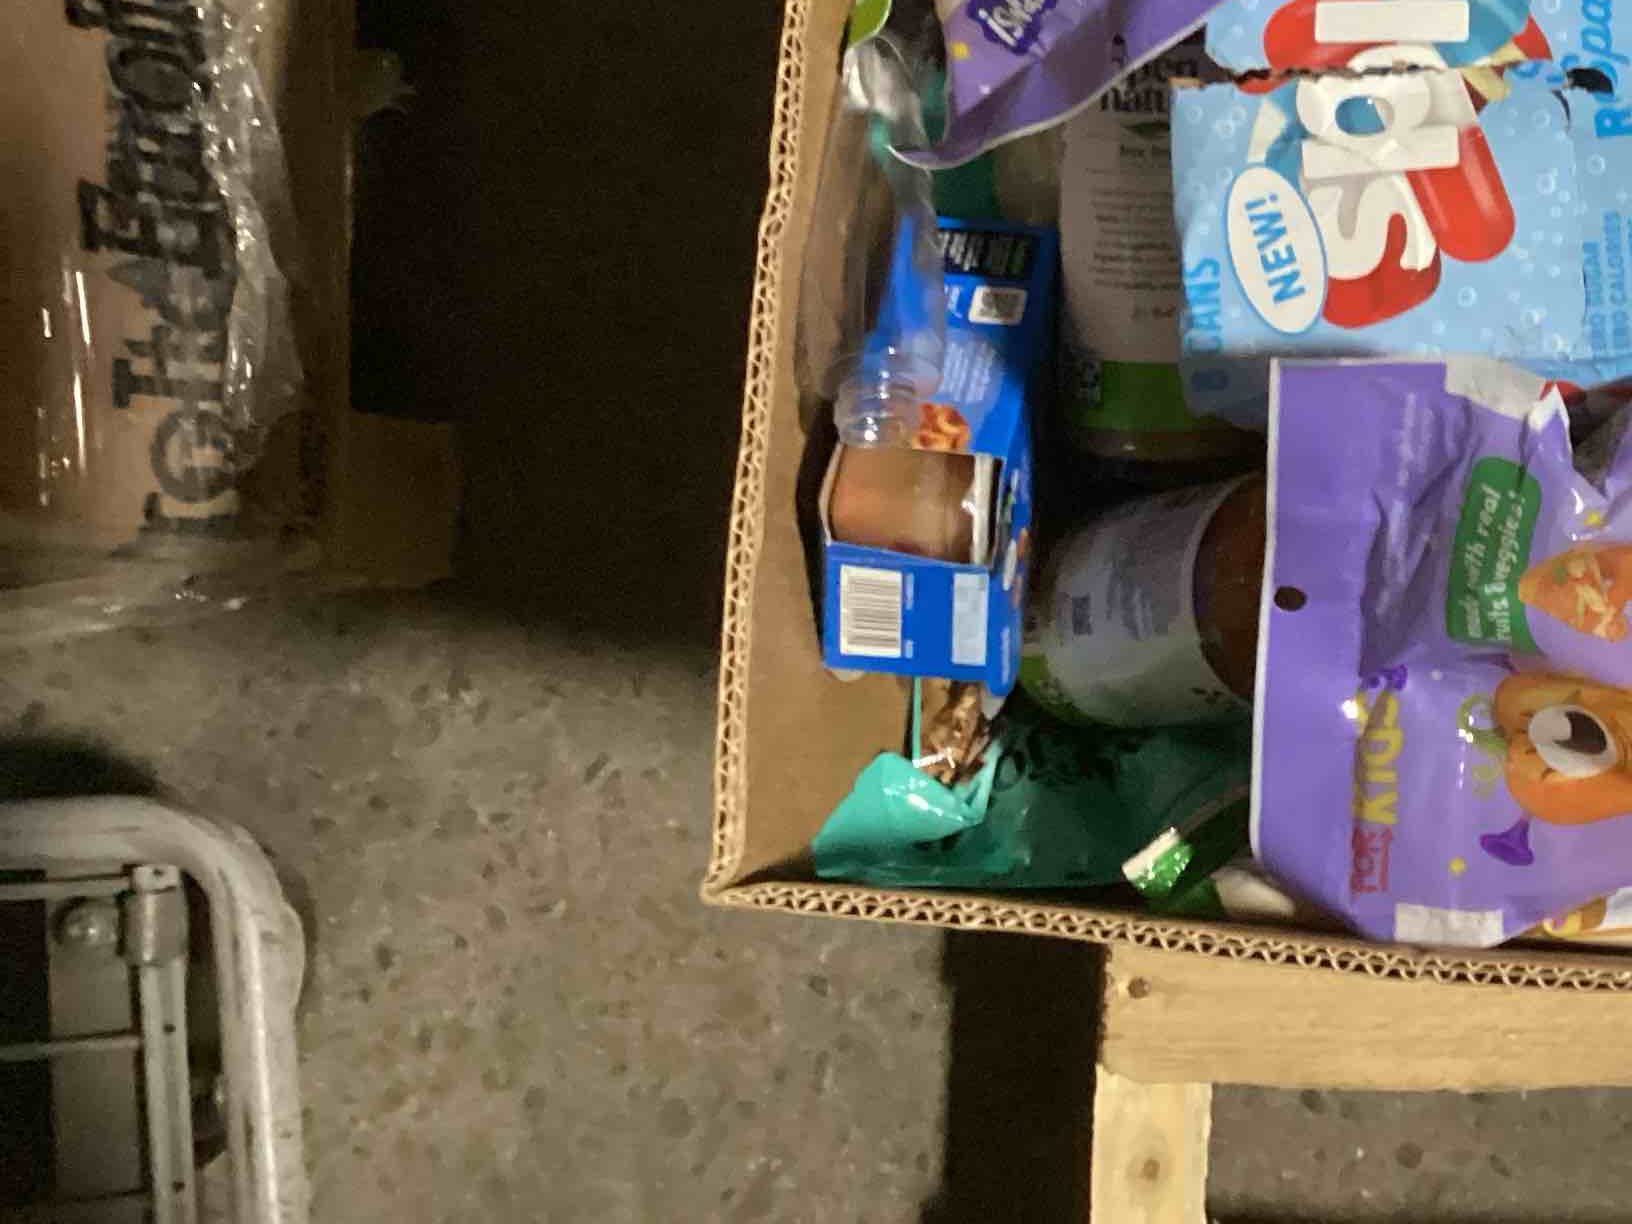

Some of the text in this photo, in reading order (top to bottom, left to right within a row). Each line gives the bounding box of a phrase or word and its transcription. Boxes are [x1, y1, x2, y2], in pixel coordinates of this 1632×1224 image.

[1244, 192, 1306, 304] NEW!
[1182, 257, 1221, 354] CANS
[1478, 482, 1500, 535] real
[1352, 691, 1404, 824] KIDS
